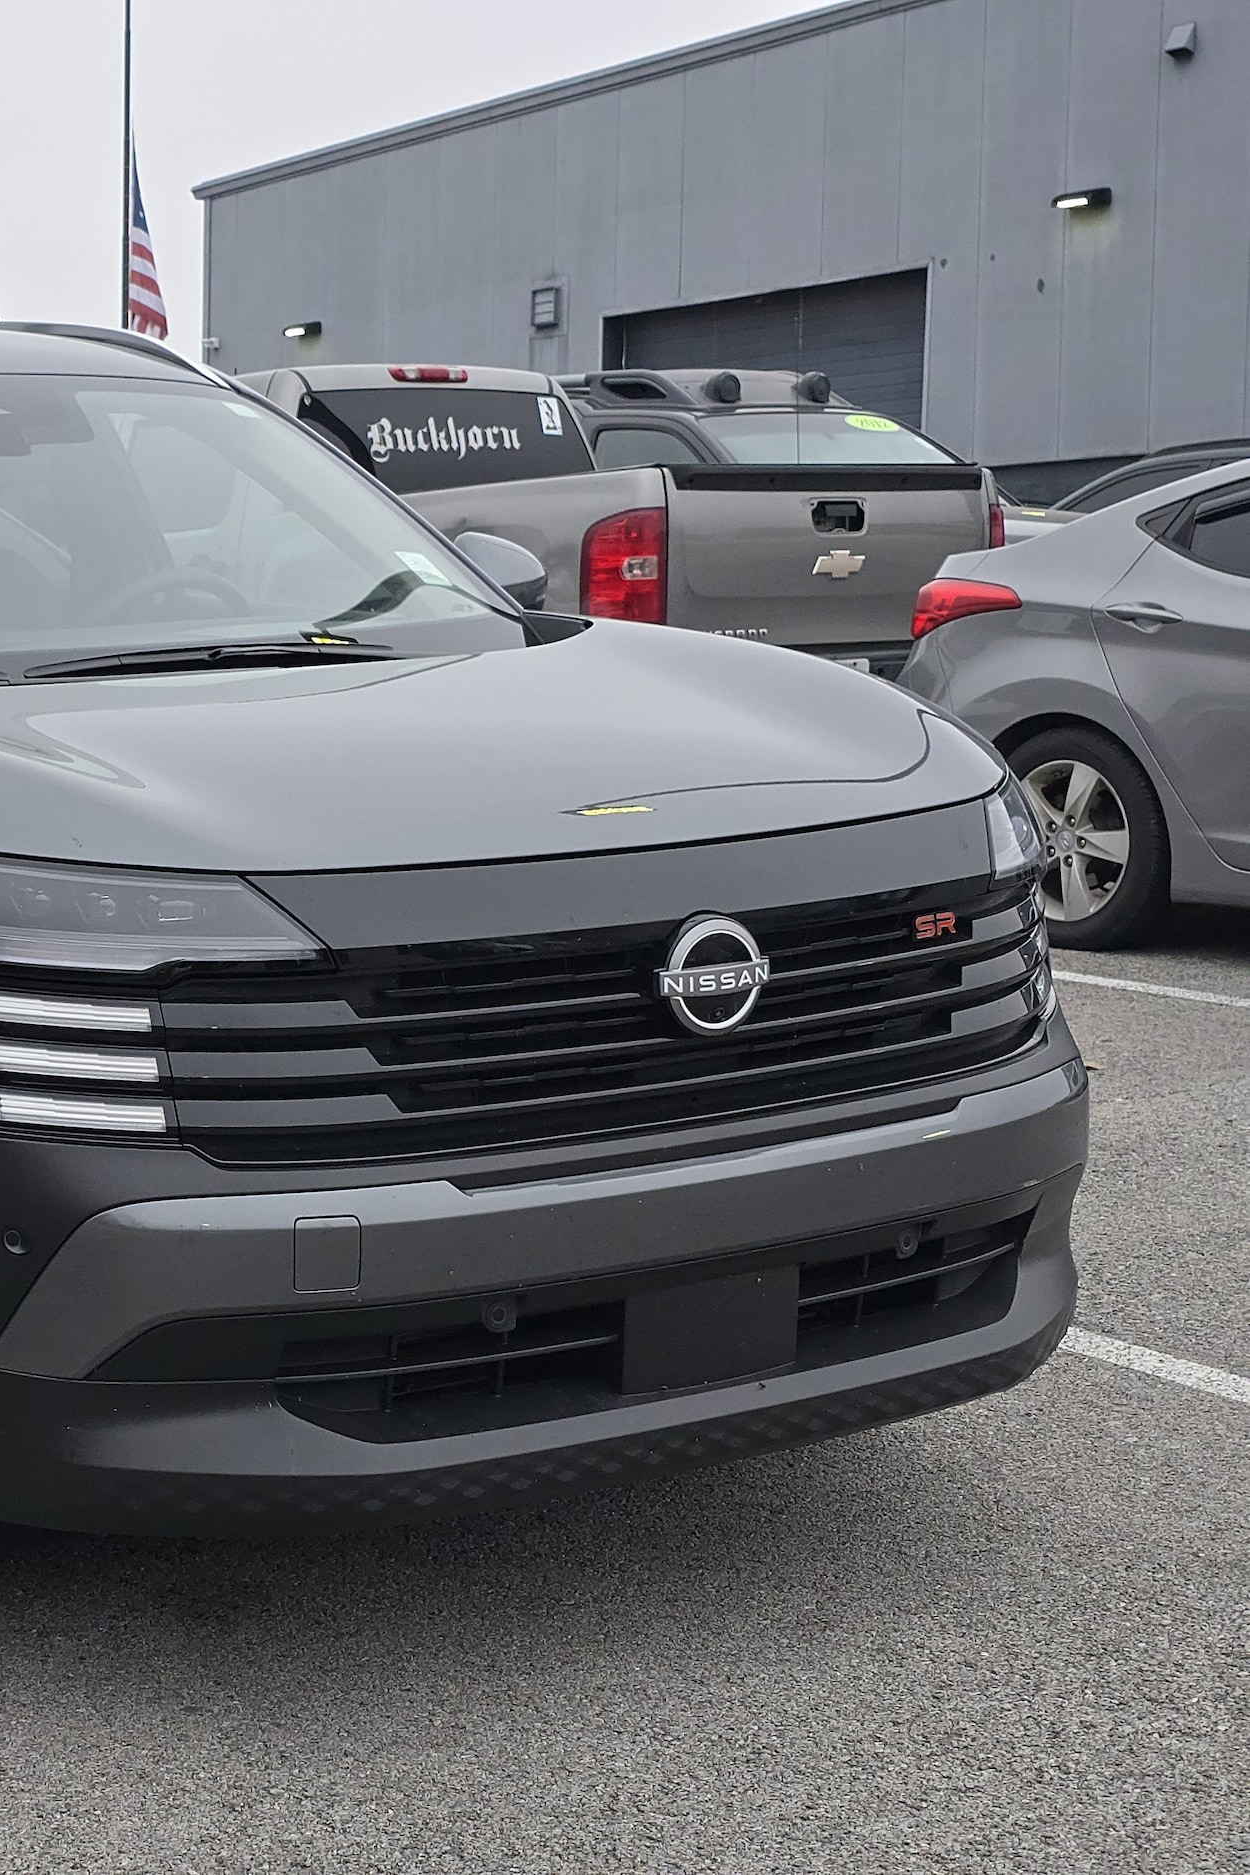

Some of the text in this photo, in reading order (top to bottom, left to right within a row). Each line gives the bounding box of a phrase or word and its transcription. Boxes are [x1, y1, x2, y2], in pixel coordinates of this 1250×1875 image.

[367, 416, 521, 463] Buckhorn
[915, 911, 956, 940] SR
[663, 964, 768, 994] NISSAN
